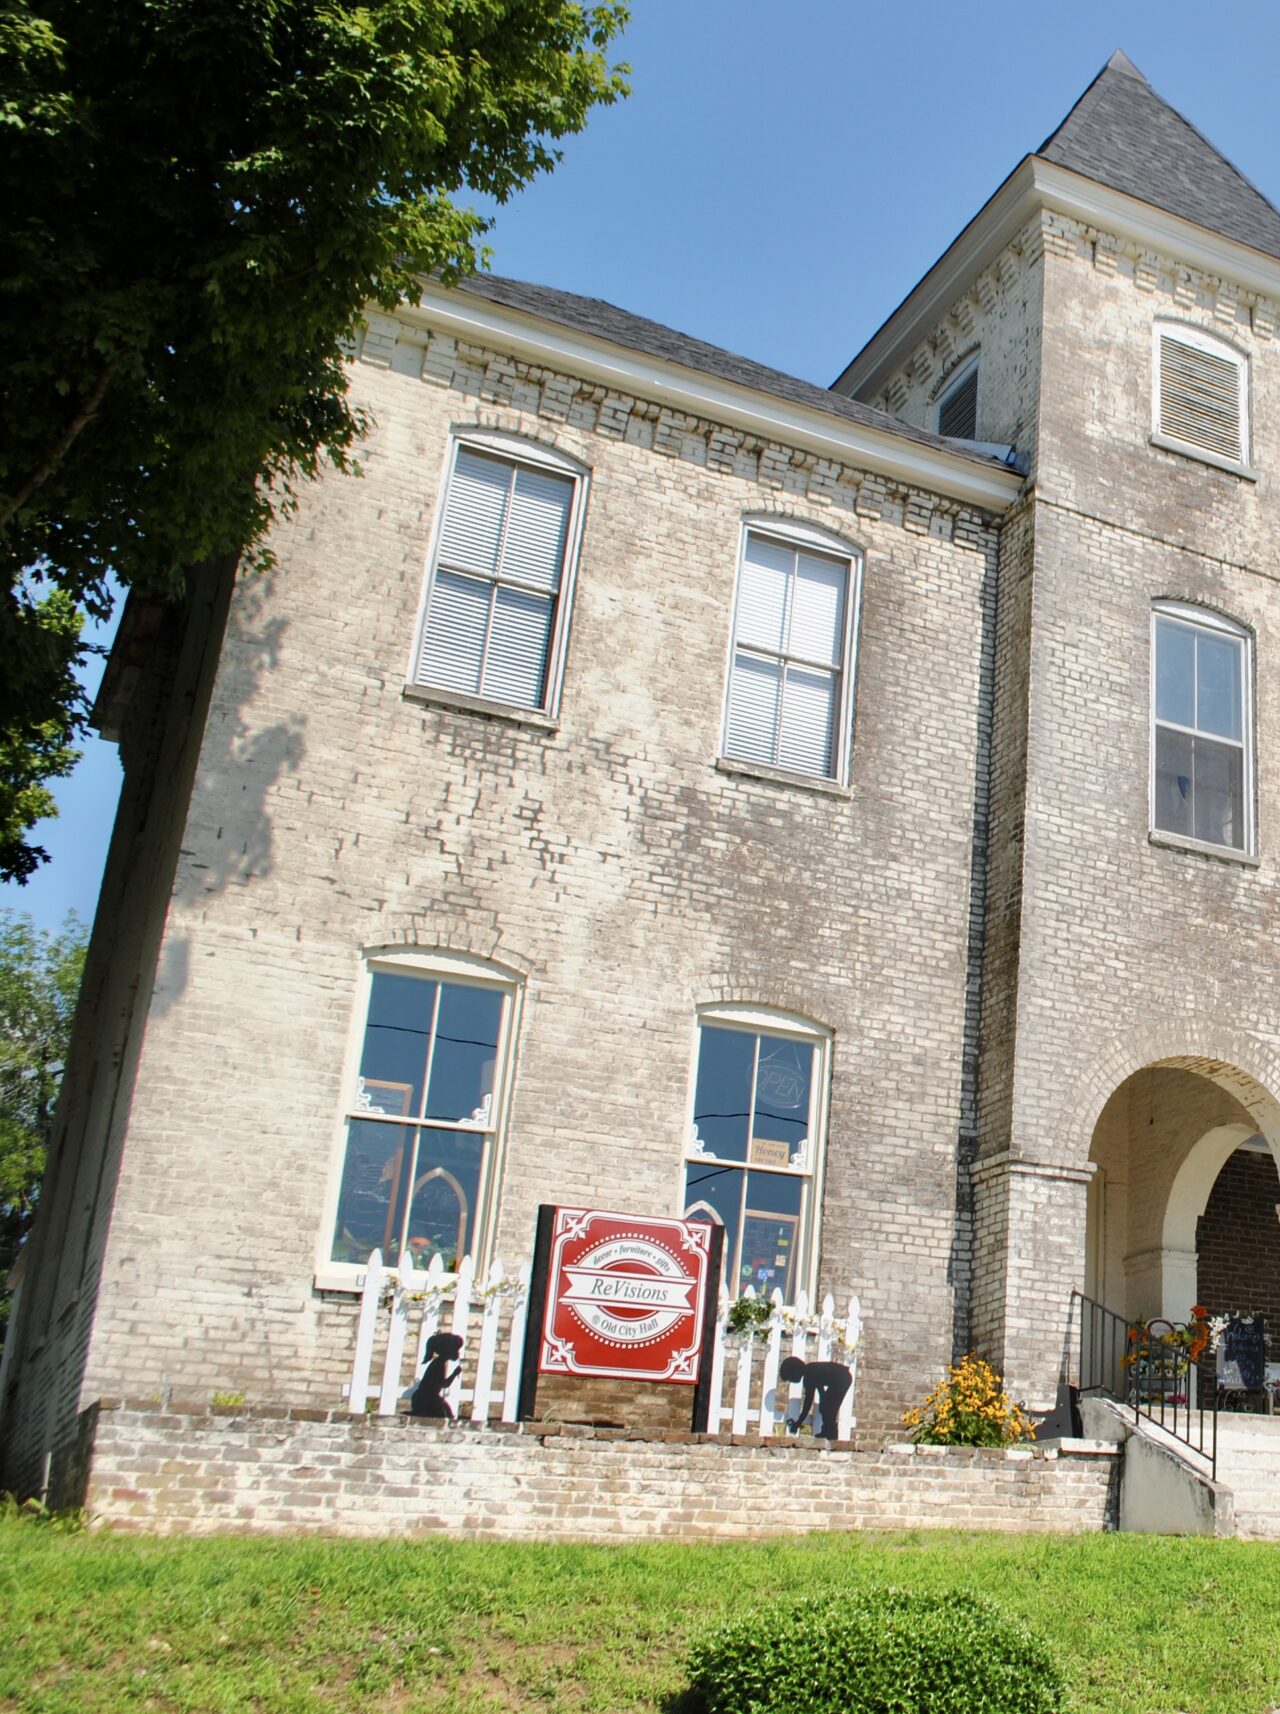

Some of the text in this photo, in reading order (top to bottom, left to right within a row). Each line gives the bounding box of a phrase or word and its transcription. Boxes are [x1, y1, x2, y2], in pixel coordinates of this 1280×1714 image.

[755, 1145, 785, 1160] Honey
[593, 1245, 670, 1272] decor furniture gifts
[590, 1278, 668, 1301] ReVisions
[601, 1319, 617, 1333] Old
[618, 1325, 637, 1338] City
[639, 1318, 659, 1333] Hall
